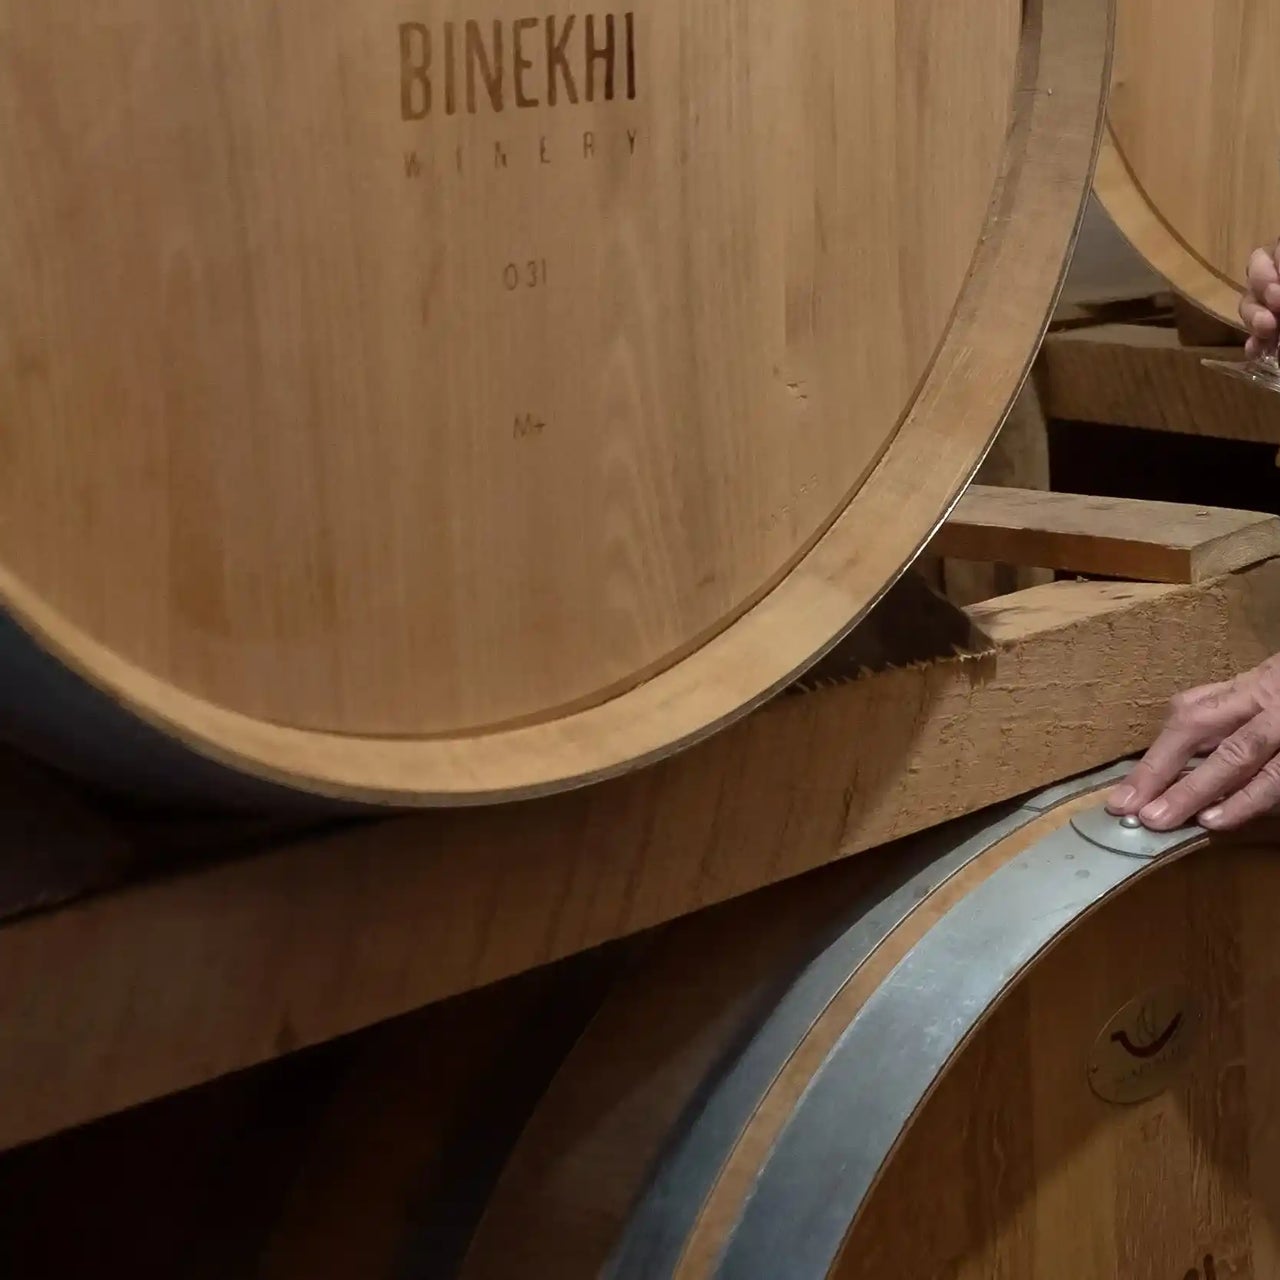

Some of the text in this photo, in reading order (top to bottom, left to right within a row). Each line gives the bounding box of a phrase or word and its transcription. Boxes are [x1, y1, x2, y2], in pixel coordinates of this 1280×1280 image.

[399, 12, 637, 122] BINEKHI
[403, 128, 638, 179] WINERY
[503, 259, 548, 292] 031
